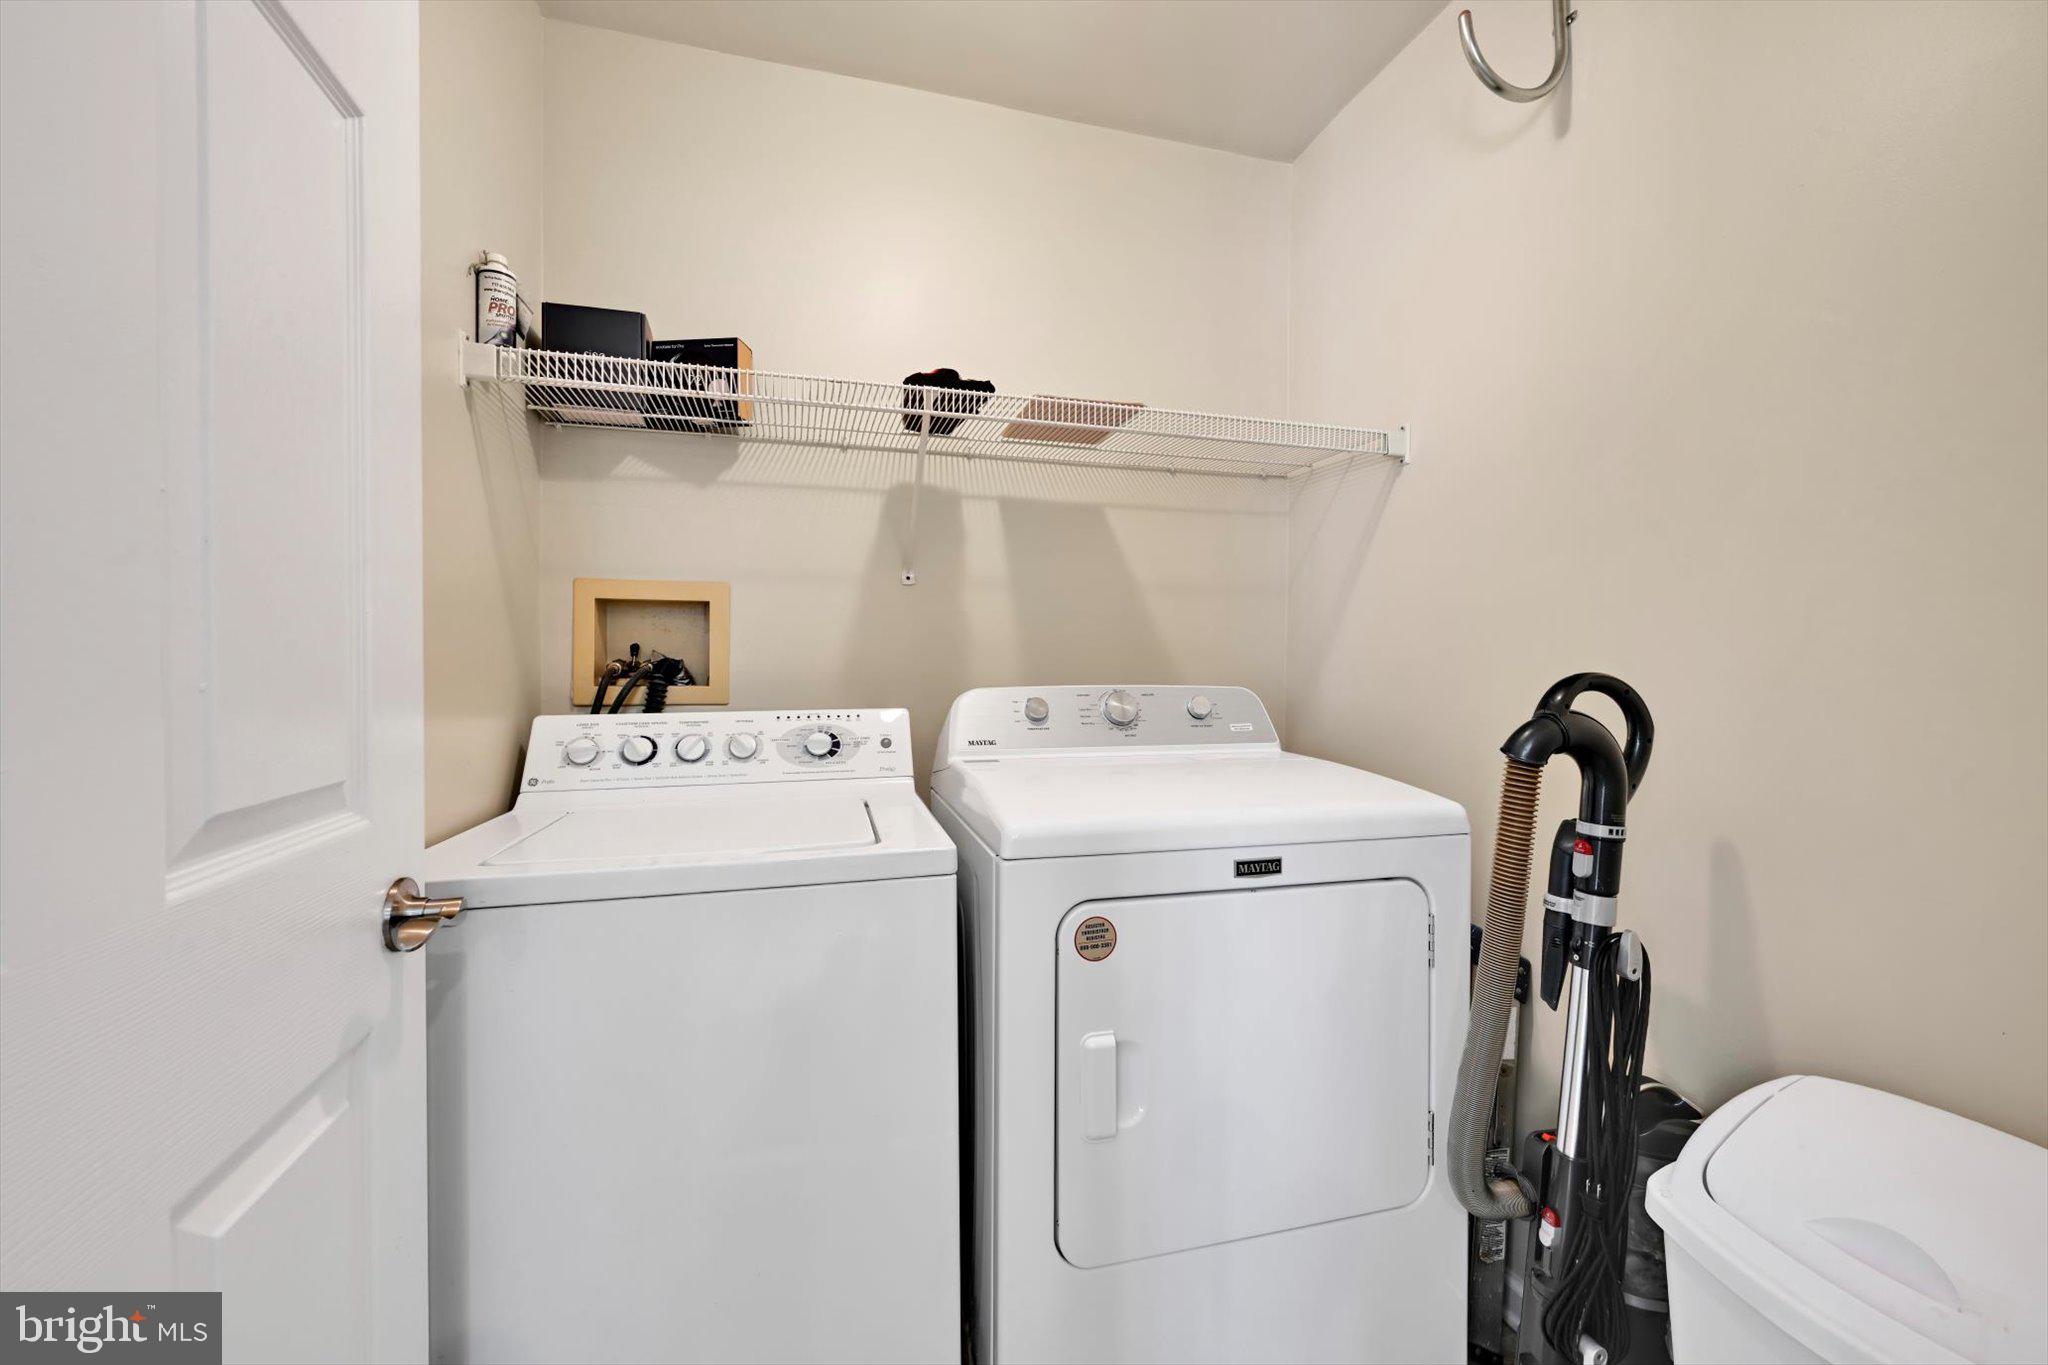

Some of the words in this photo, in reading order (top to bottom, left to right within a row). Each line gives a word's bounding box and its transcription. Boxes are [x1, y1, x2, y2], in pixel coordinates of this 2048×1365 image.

[488, 302, 515, 316] PRO
[967, 739, 997, 747] MAYTAG
[1238, 861, 1280, 874] MAYTAG
